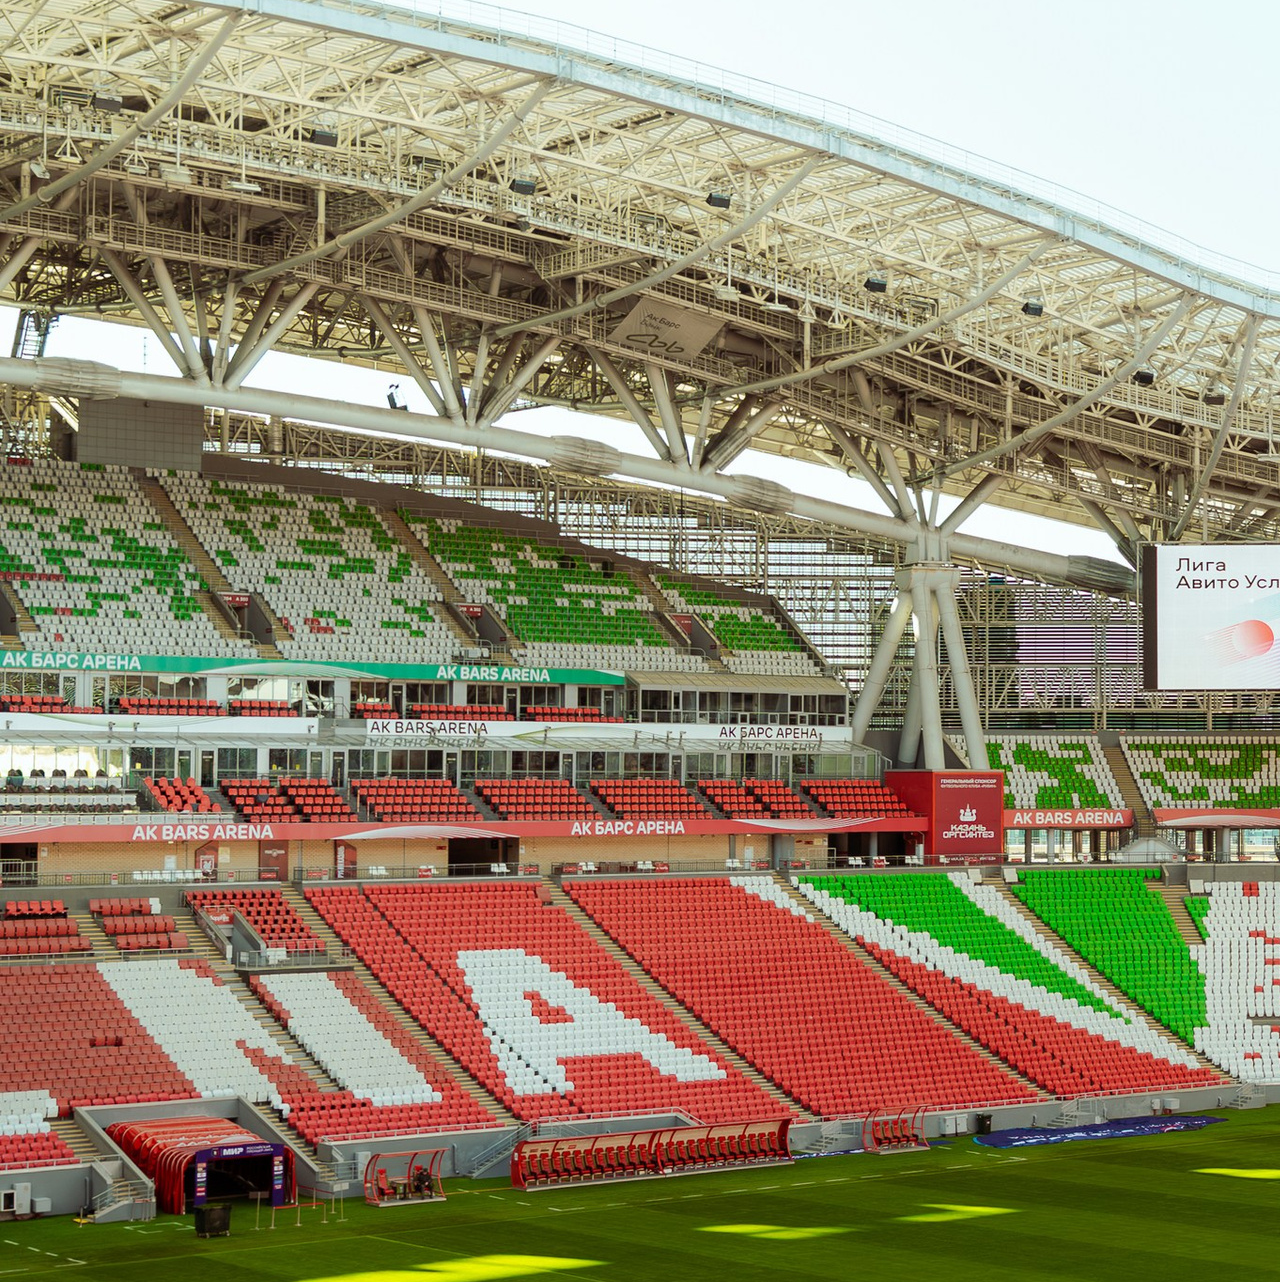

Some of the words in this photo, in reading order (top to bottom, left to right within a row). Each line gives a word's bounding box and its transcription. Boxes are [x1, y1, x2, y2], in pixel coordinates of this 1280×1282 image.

[659, 317, 681, 329] Барс
[1175, 558, 1226, 572] Лига
[1176, 575, 1239, 589] Авито
[2, 652, 27, 667] АК
[31, 653, 79, 668] БАРС
[82, 654, 141, 670] АРЕНА
[437, 666, 458, 679] AK
[460, 667, 498, 681] BARS
[502, 668, 550, 682] ARENA
[370, 721, 390, 733] AK
[395, 721, 435, 734] BARS
[438, 722, 488, 735] ARENA
[719, 726, 737, 738] АК
[741, 727, 773, 739] БАРС
[776, 727, 818, 739] АРЕНА
[1013, 812, 1033, 824] AK
[1035, 812, 1072, 824] BARS
[1075, 812, 1124, 824] ARENA
[132, 825, 157, 840] AK
[162, 825, 209, 840] BARS
[213, 824, 274, 840] ARENA
[571, 821, 592, 835] АК
[595, 821, 634, 835] БАРС
[636, 820, 685, 834] АРЕНА
[950, 824, 986, 832] КАЗАНЬ
[223, 1147, 244, 1156] МИР
